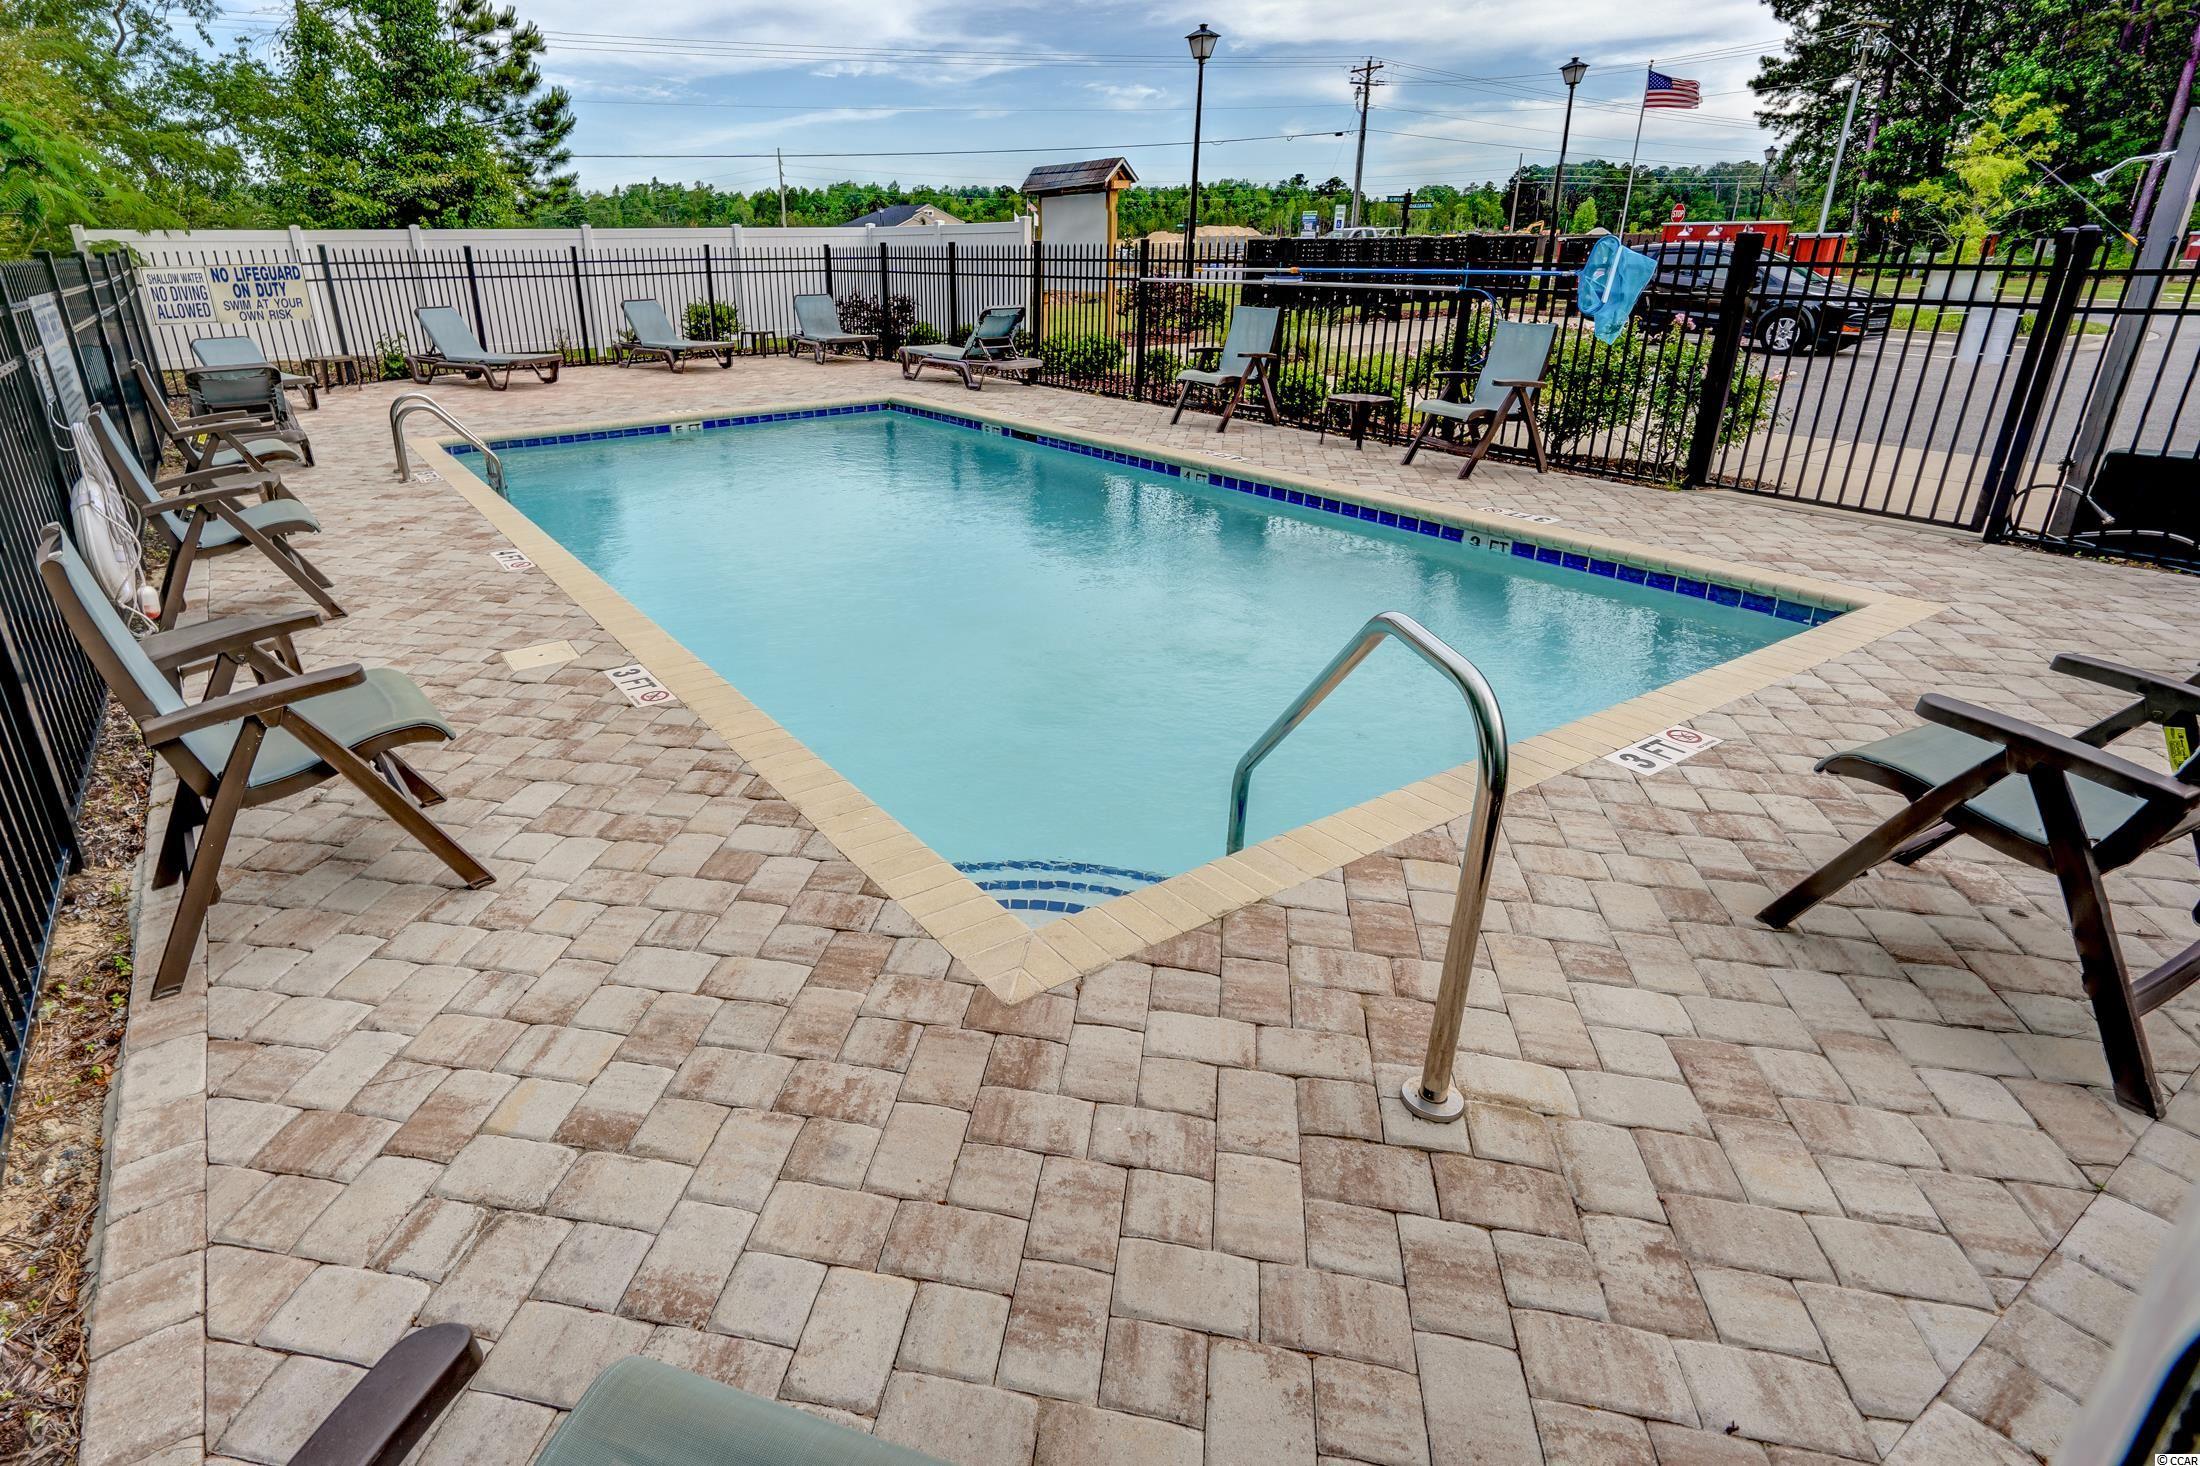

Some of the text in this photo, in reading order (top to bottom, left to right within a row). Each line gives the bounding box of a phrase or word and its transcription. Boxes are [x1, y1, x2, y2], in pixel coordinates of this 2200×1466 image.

[1671, 210, 1685, 218] STOP
[146, 272, 205, 285] SHALLOW WATER
[210, 265, 301, 283] NO LIFEGUARD
[150, 285, 209, 302] NO DIVING
[232, 281, 286, 298] ON DUTY
[157, 302, 212, 320] ALLOWED
[223, 297, 304, 311] SWIM AT YOUR
[239, 309, 294, 322] OWN RISK
[1469, 535, 1510, 553] 3 FT
[612, 668, 658, 691] 3 FT
[1636, 738, 1687, 761] FT
[1618, 753, 1657, 769] 3
